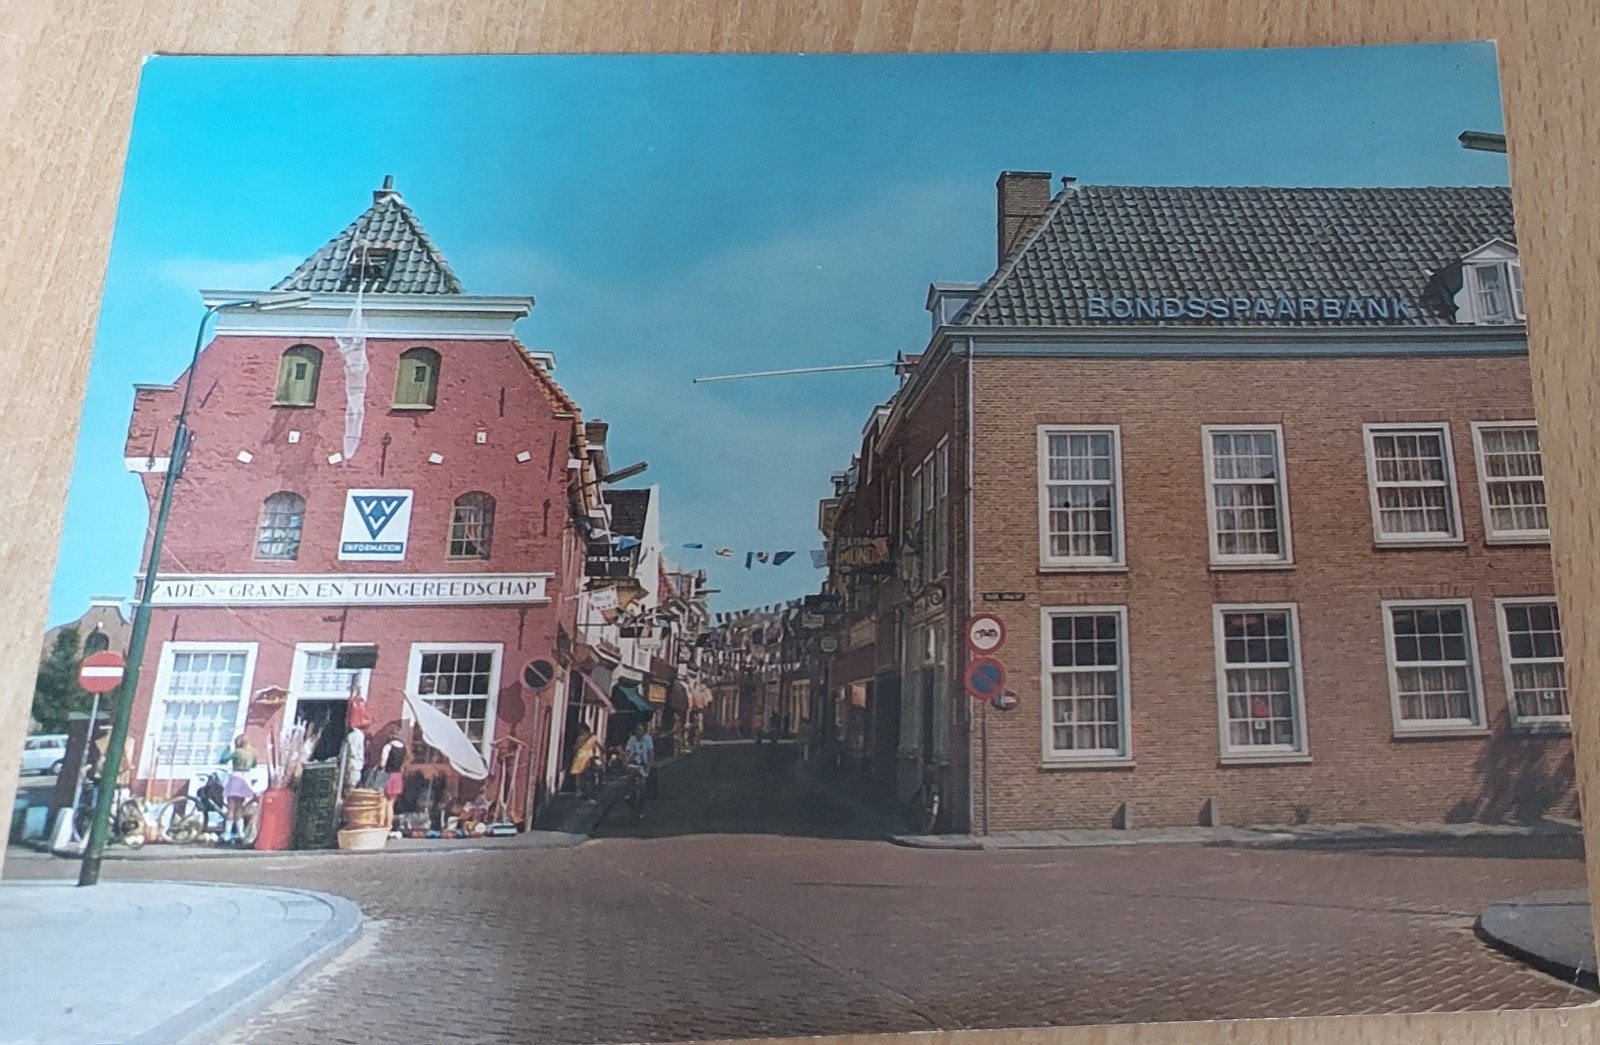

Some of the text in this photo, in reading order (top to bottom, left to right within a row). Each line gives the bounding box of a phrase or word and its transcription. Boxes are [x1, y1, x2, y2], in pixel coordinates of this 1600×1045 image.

[1086, 297, 1412, 319] BONDSSPAARBANK
[316, 582, 344, 598] EN
[352, 580, 538, 597] TUINGEREEDSCHAP
